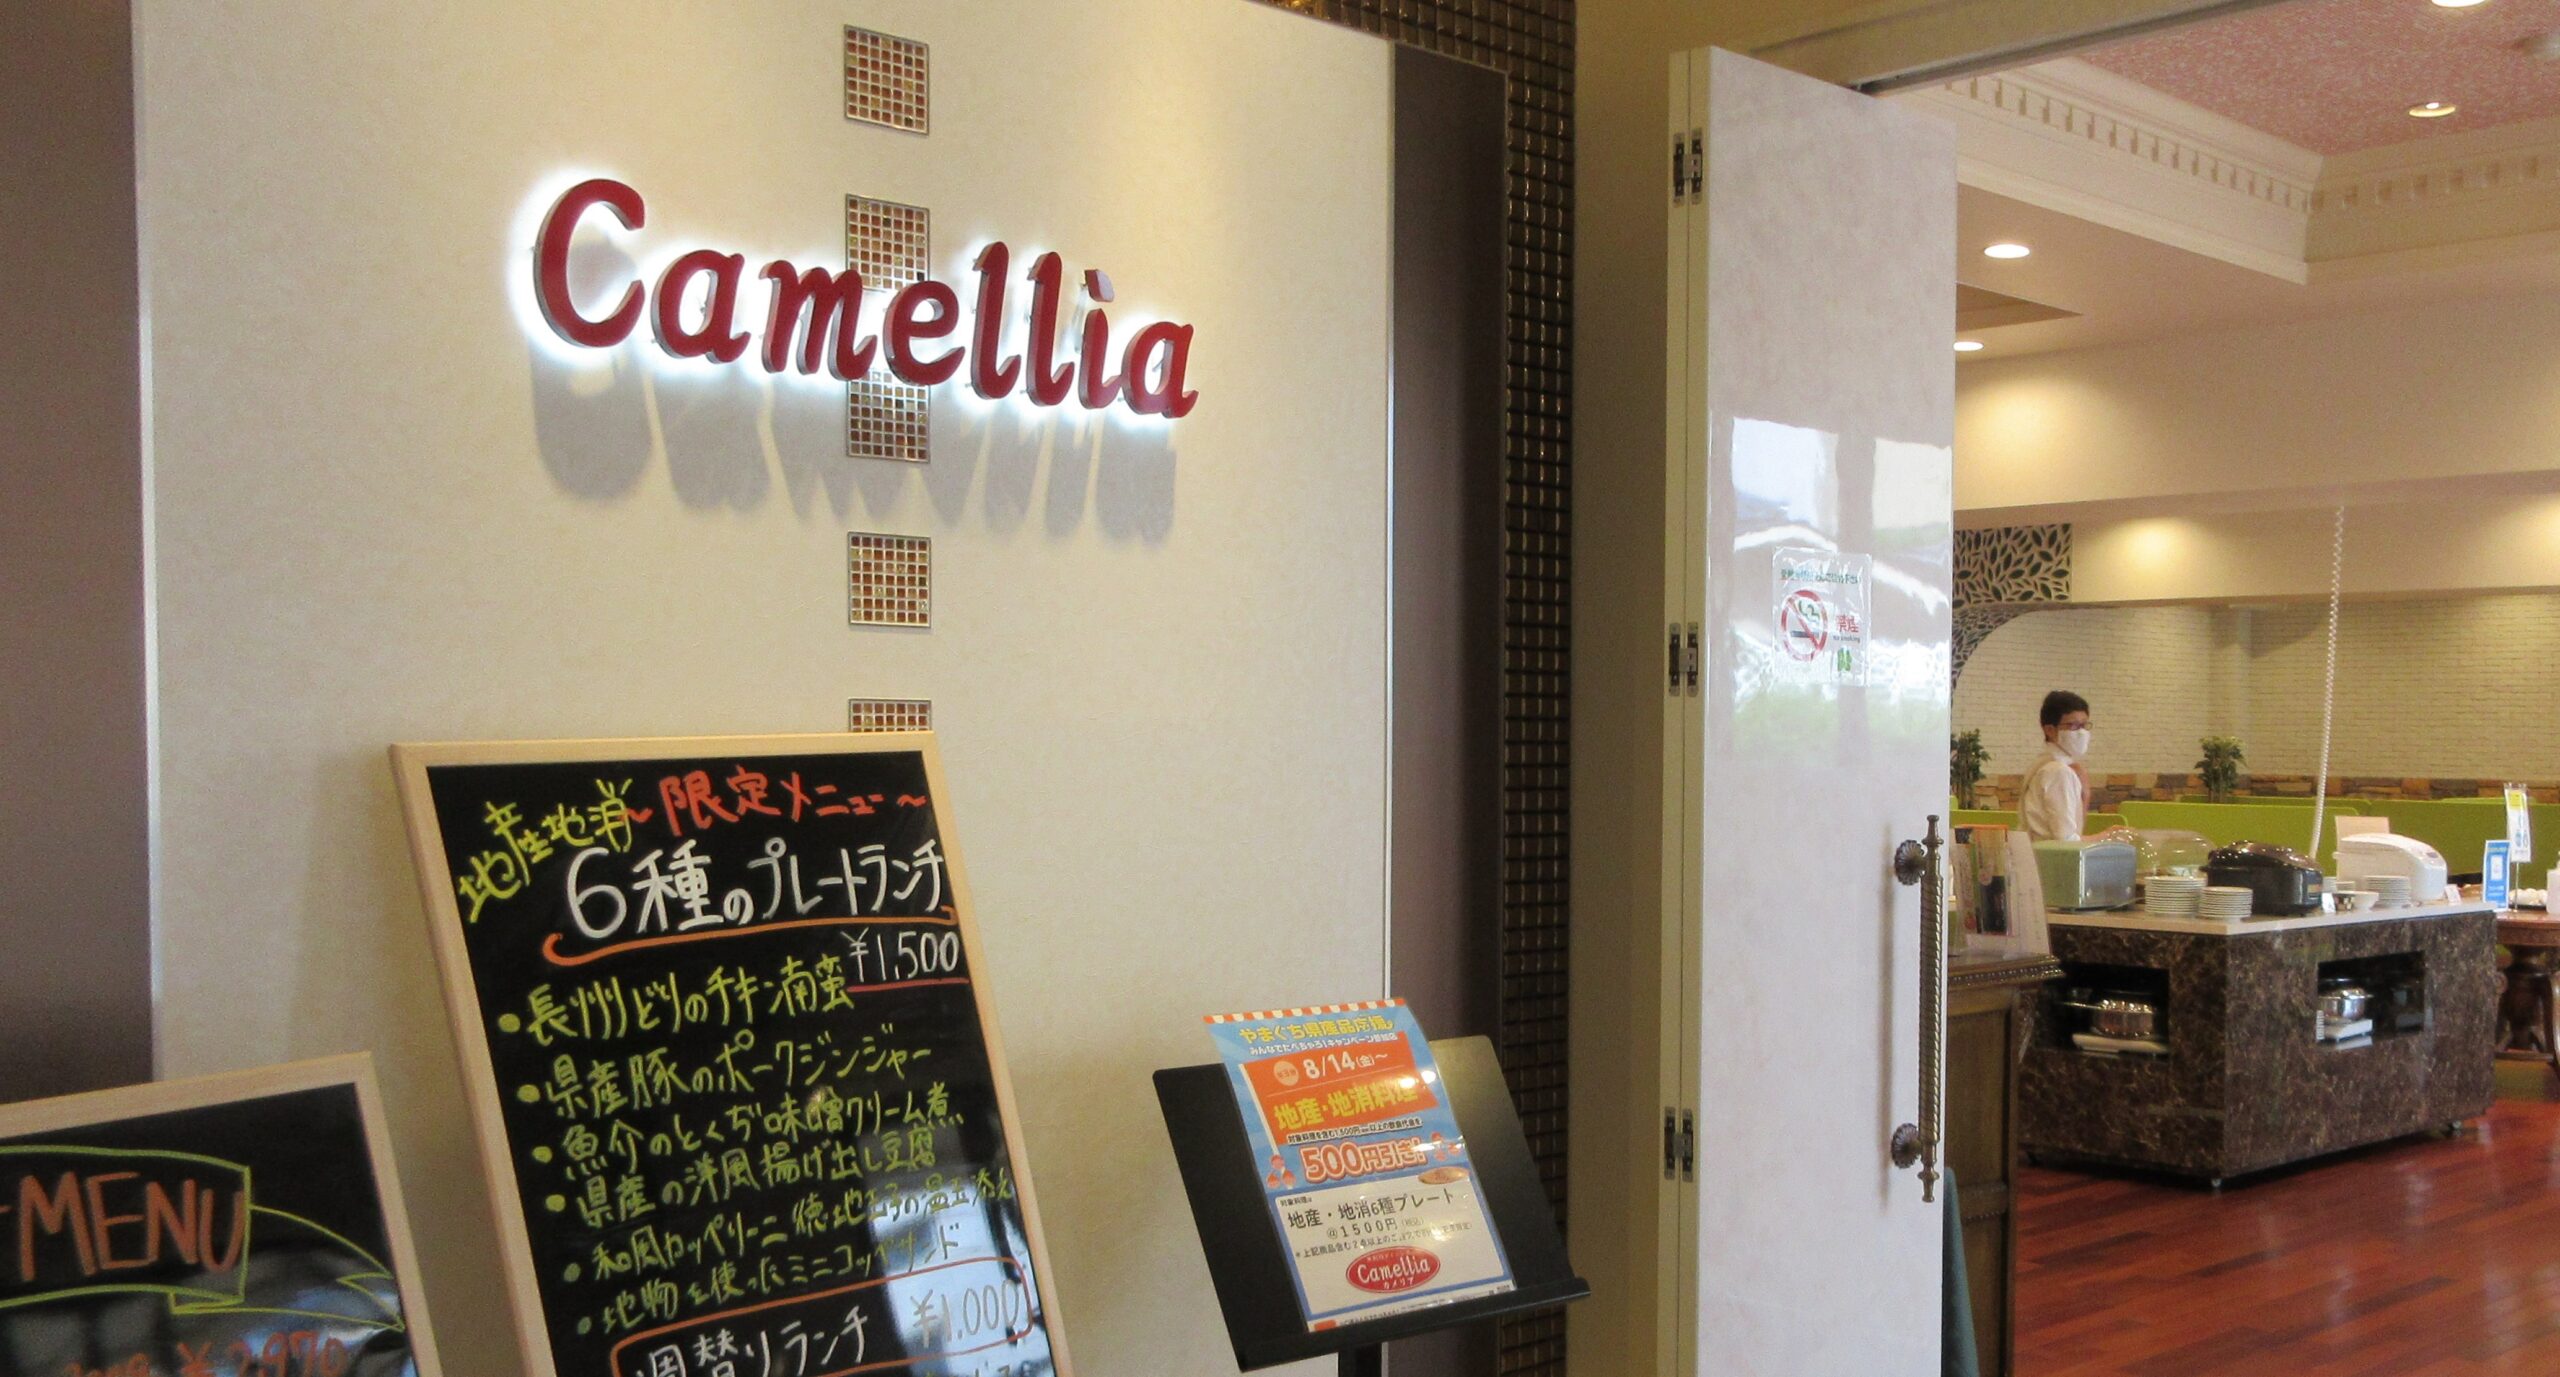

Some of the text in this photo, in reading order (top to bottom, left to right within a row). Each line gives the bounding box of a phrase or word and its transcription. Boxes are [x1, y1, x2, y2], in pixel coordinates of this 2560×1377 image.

[533, 178, 1199, 419] Camellia
[566, 837, 944, 939] 6種のプレートランチ
[19, 1171, 245, 1282] MENU
[1357, 1256, 1431, 1284] Camellia
